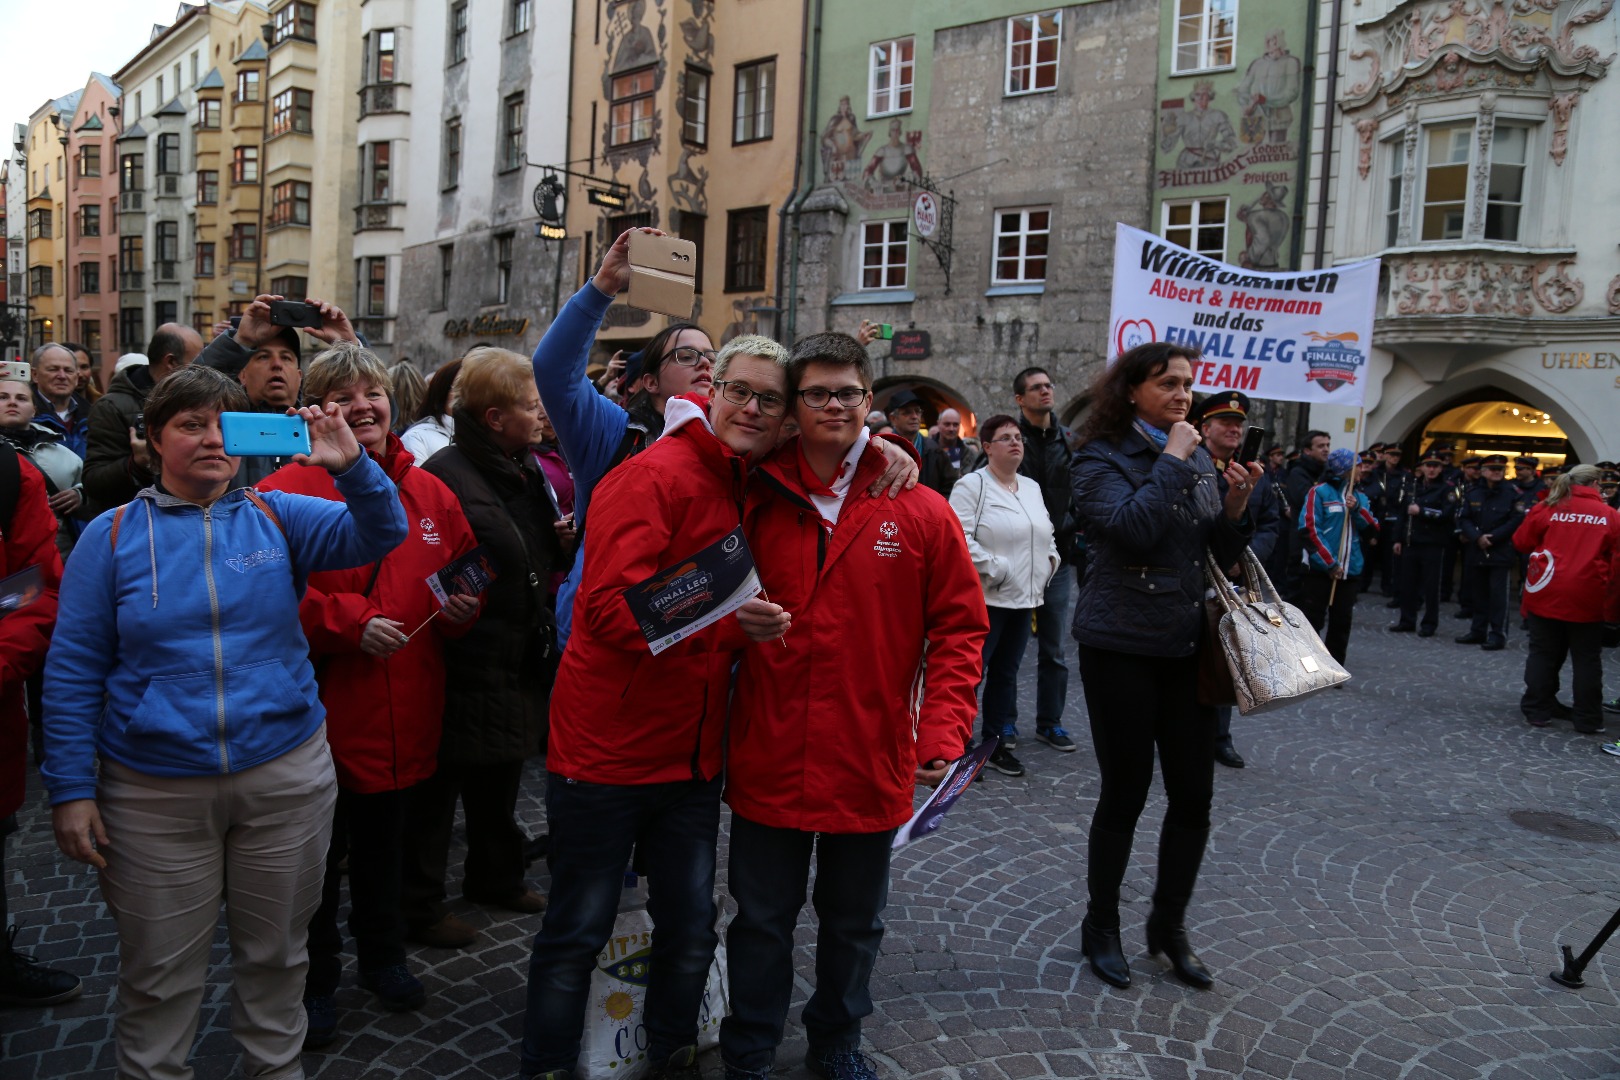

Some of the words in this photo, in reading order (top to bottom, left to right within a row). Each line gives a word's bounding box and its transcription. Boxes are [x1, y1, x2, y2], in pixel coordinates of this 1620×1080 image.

[1149, 278, 1205, 305] Albert
[1208, 289, 1223, 307] &
[1228, 290, 1323, 315] Hermann
[1193, 311, 1230, 329] und
[1229, 312, 1265, 332] das
[1165, 326, 1235, 358] FINAL
[1243, 336, 1297, 363] LEG
[1306, 351, 1338, 362] FINAL
[1339, 353, 1361, 365] LEG
[1192, 360, 1263, 391] TEAM
[1550, 512, 1607, 526] AUSTRIA
[654, 586, 686, 609] FINAL
[686, 575, 708, 591] LEG
